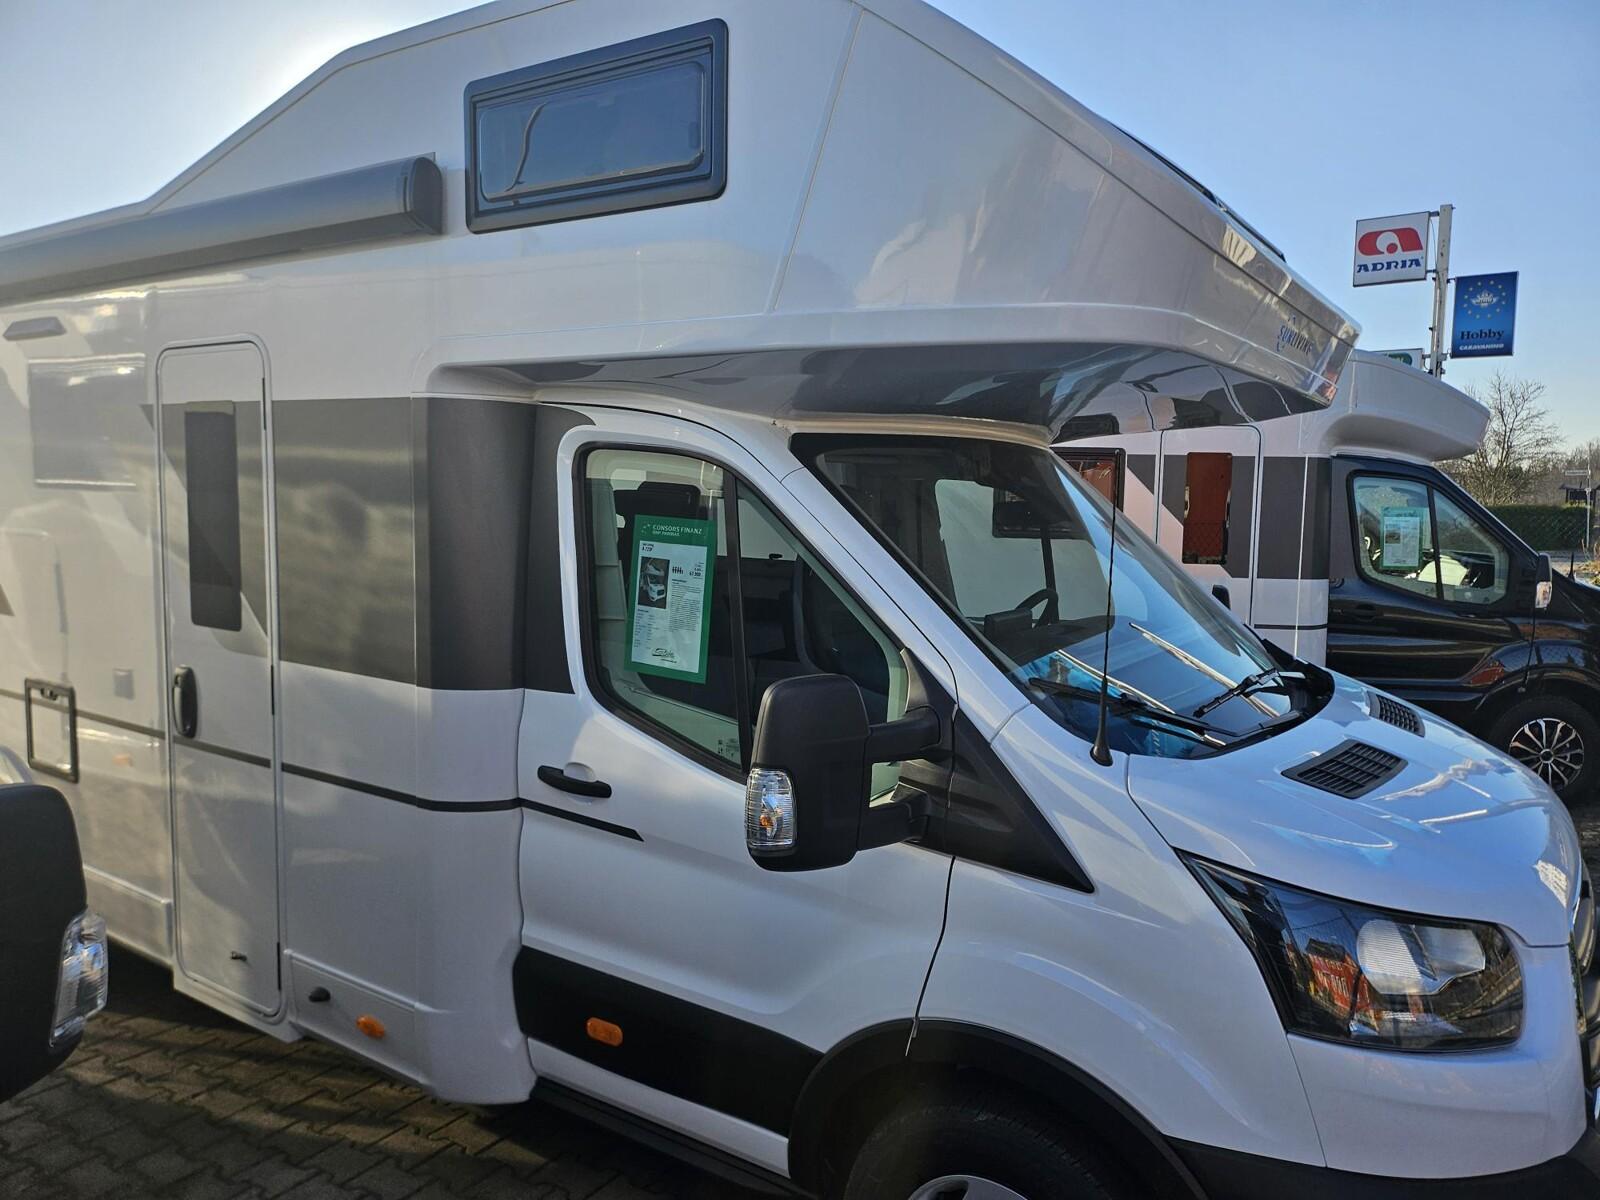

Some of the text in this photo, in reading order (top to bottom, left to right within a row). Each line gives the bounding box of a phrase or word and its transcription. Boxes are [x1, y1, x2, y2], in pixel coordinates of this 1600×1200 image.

[1357, 258, 1421, 273] ADRIA
[1460, 328, 1504, 340] Hobby
[652, 524, 703, 535] CONSORS FINANZ
